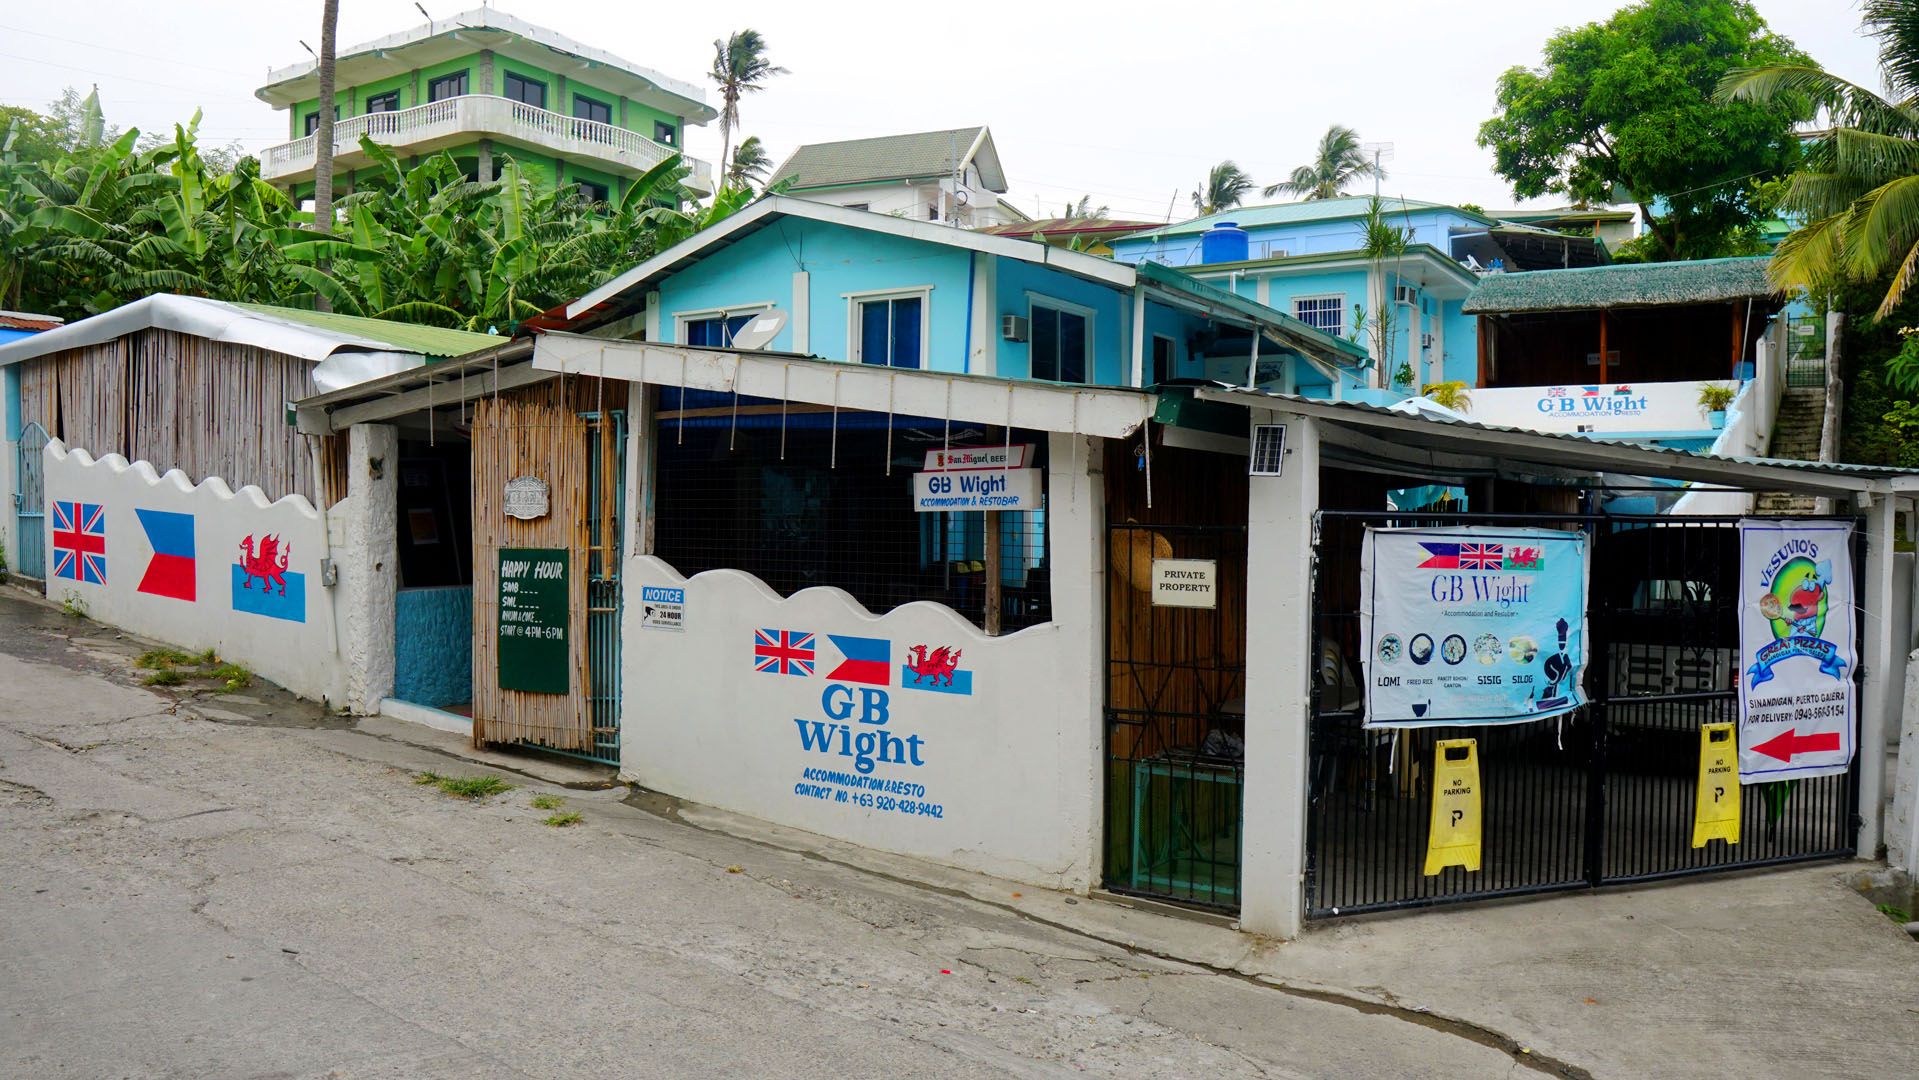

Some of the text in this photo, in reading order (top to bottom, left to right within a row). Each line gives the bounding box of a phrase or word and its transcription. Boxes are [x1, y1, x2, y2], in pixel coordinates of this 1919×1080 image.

[1582, 396, 1648, 416] Wight
[947, 454, 1008, 464] San Miguel BEE
[928, 475, 1006, 496] GB Wight
[920, 497, 970, 506] ACCOMMODATION
[979, 496, 1020, 506] RESTOBAR
[501, 560, 563, 579] HAPPY HOUR
[1761, 539, 1819, 587] VESUVIO'S
[1164, 570, 1206, 579] PRIVATE
[1160, 583, 1211, 592] PROPERTY
[1431, 575, 1529, 609] GB Wight
[646, 589, 682, 602] NOTICE
[667, 612, 682, 620] HOUR
[500, 625, 563, 640] START @ 4PM-6PM
[1794, 638, 1830, 654] PIZZAS
[1378, 676, 1400, 686] LOMI
[1478, 675, 1502, 685] SISIG
[1512, 675, 1533, 684] SILOG
[822, 684, 890, 725] GB
[1750, 697, 1795, 709] SINANDIGAN,
[1796, 693, 1820, 704] PUERTO
[1748, 714, 1760, 723] FOR
[1760, 711, 1793, 722] DELIVERY:
[794, 719, 925, 774] Wight
[803, 767, 884, 791] ACCOMMODATION
[1444, 787, 1471, 795] PARKING
[795, 783, 943, 818] CONTACT NO. +63 920-428-9442
